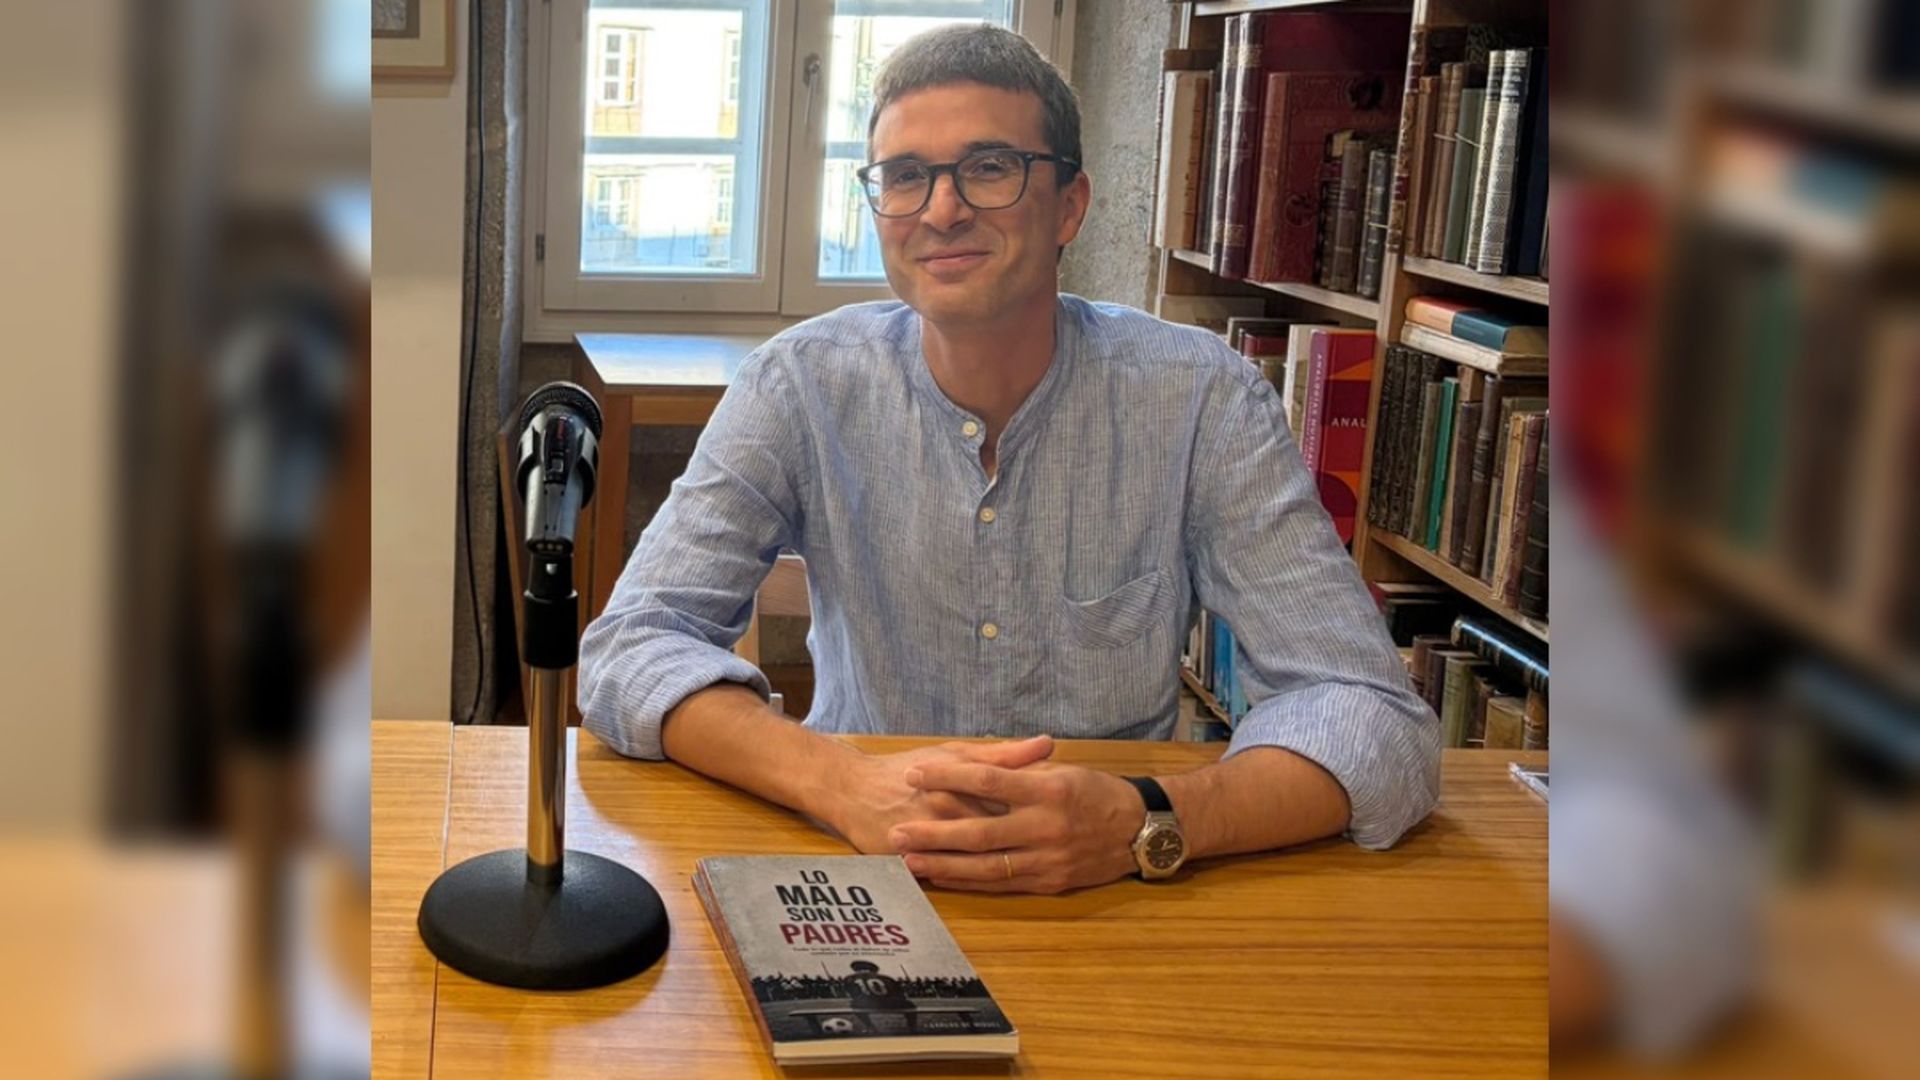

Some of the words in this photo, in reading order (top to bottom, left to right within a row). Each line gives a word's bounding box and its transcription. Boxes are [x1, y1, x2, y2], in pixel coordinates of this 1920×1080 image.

[800, 870, 829, 884] LO
[775, 885, 873, 906] MALO
[787, 907, 835, 922] SON
[838, 907, 884, 922] LOS
[780, 923, 910, 945] PADRES
[854, 979, 887, 995] 10
